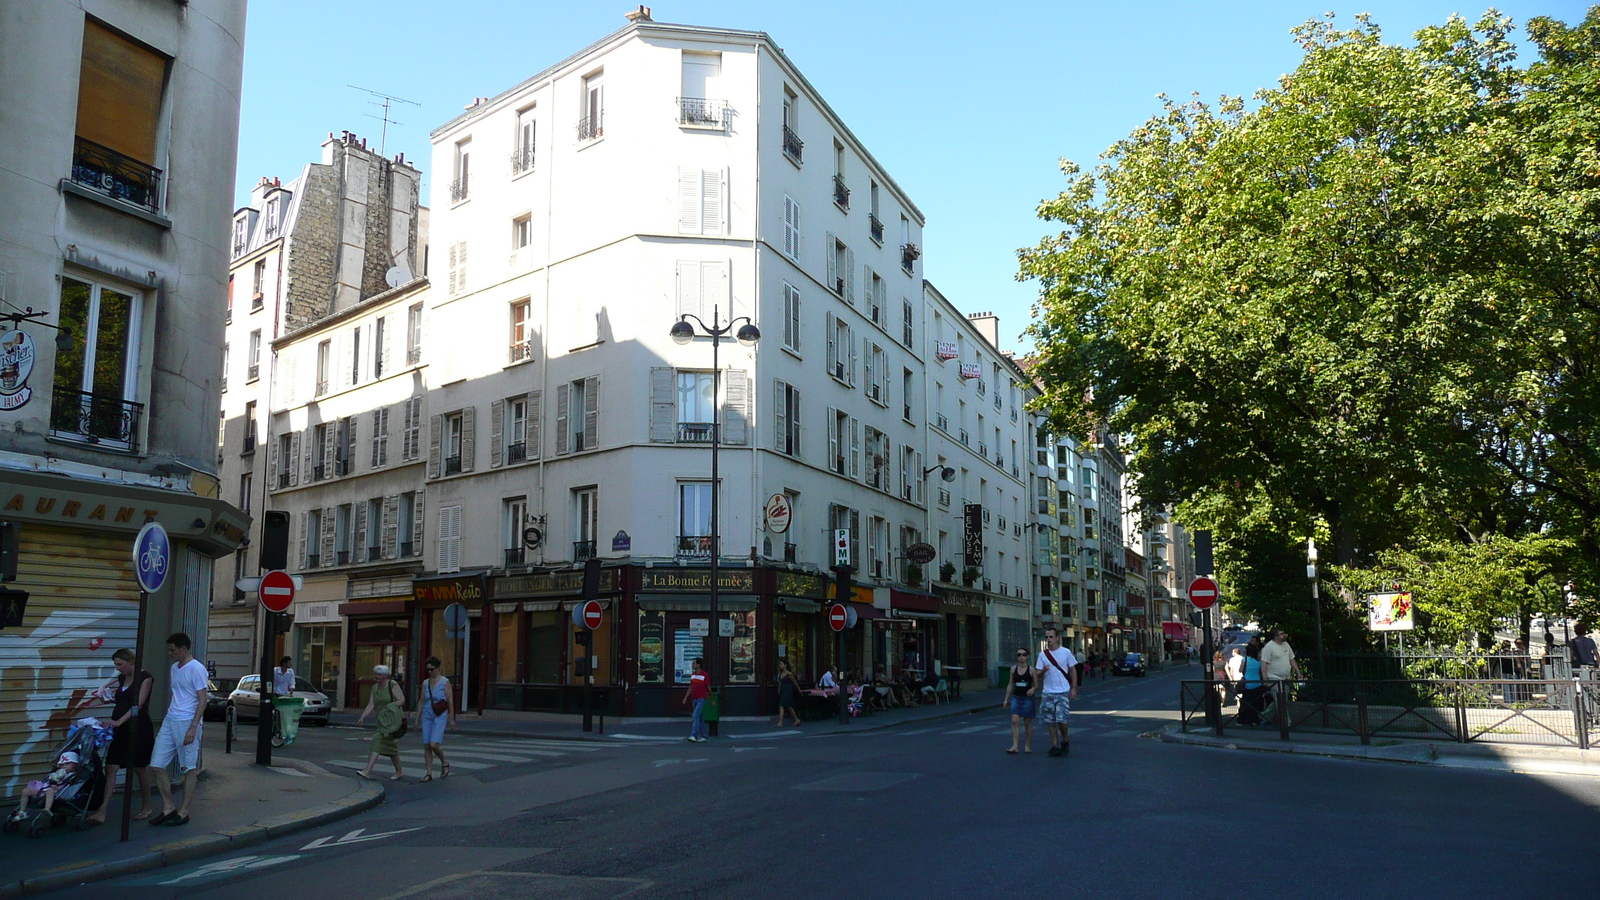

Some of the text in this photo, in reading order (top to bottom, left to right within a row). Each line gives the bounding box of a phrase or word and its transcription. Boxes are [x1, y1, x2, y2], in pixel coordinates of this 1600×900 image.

[0, 344, 31, 367] ischer
[973, 531, 982, 565] VALMY
[501, 579, 553, 592] BOULANGER
[653, 574, 666, 586] La
[668, 574, 700, 586] Bonne
[455, 582, 481, 601] Resto
